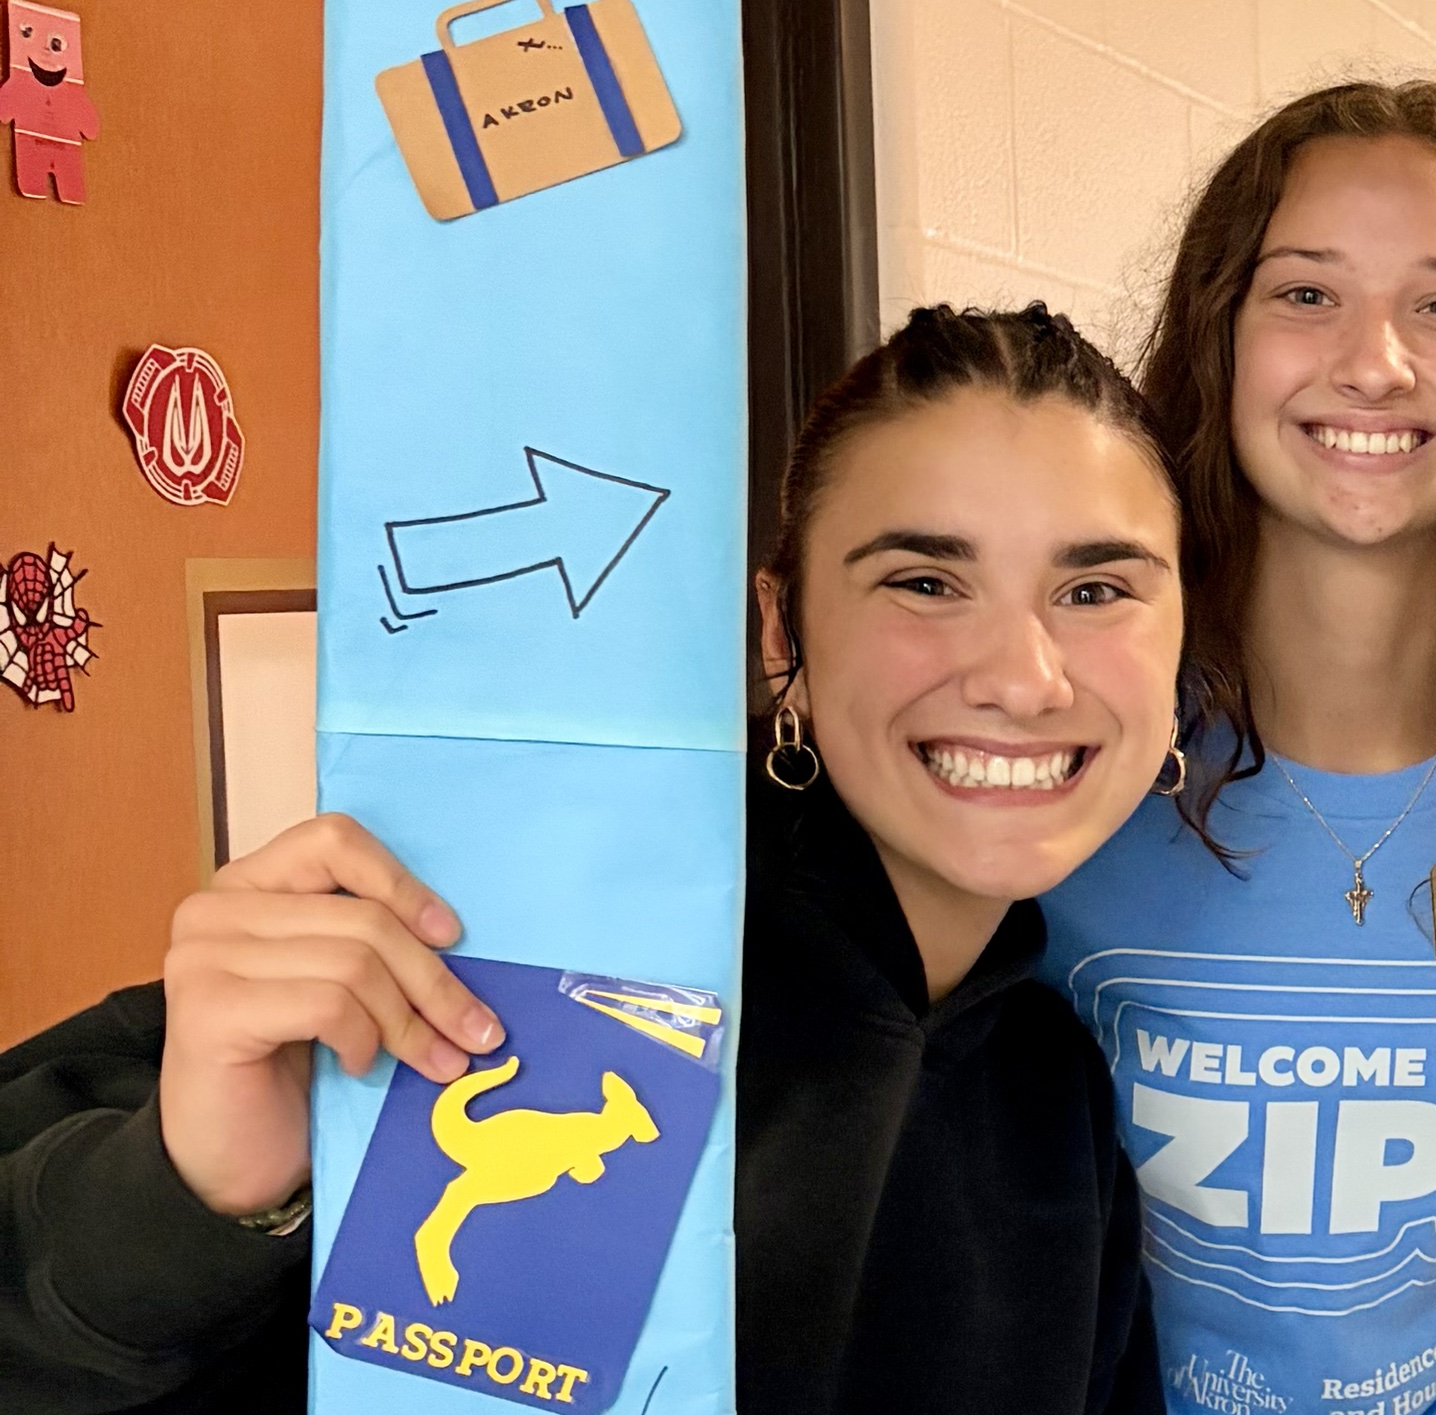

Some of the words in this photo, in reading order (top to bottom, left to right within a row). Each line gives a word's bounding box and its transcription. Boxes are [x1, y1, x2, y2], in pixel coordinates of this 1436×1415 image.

[482, 86, 574, 129] AKRON
[1135, 1028, 1427, 1087] WELCOME
[325, 1301, 590, 1404] PASSPORT
[1226, 1348, 1265, 1389] The
[1188, 1353, 1294, 1414] University
